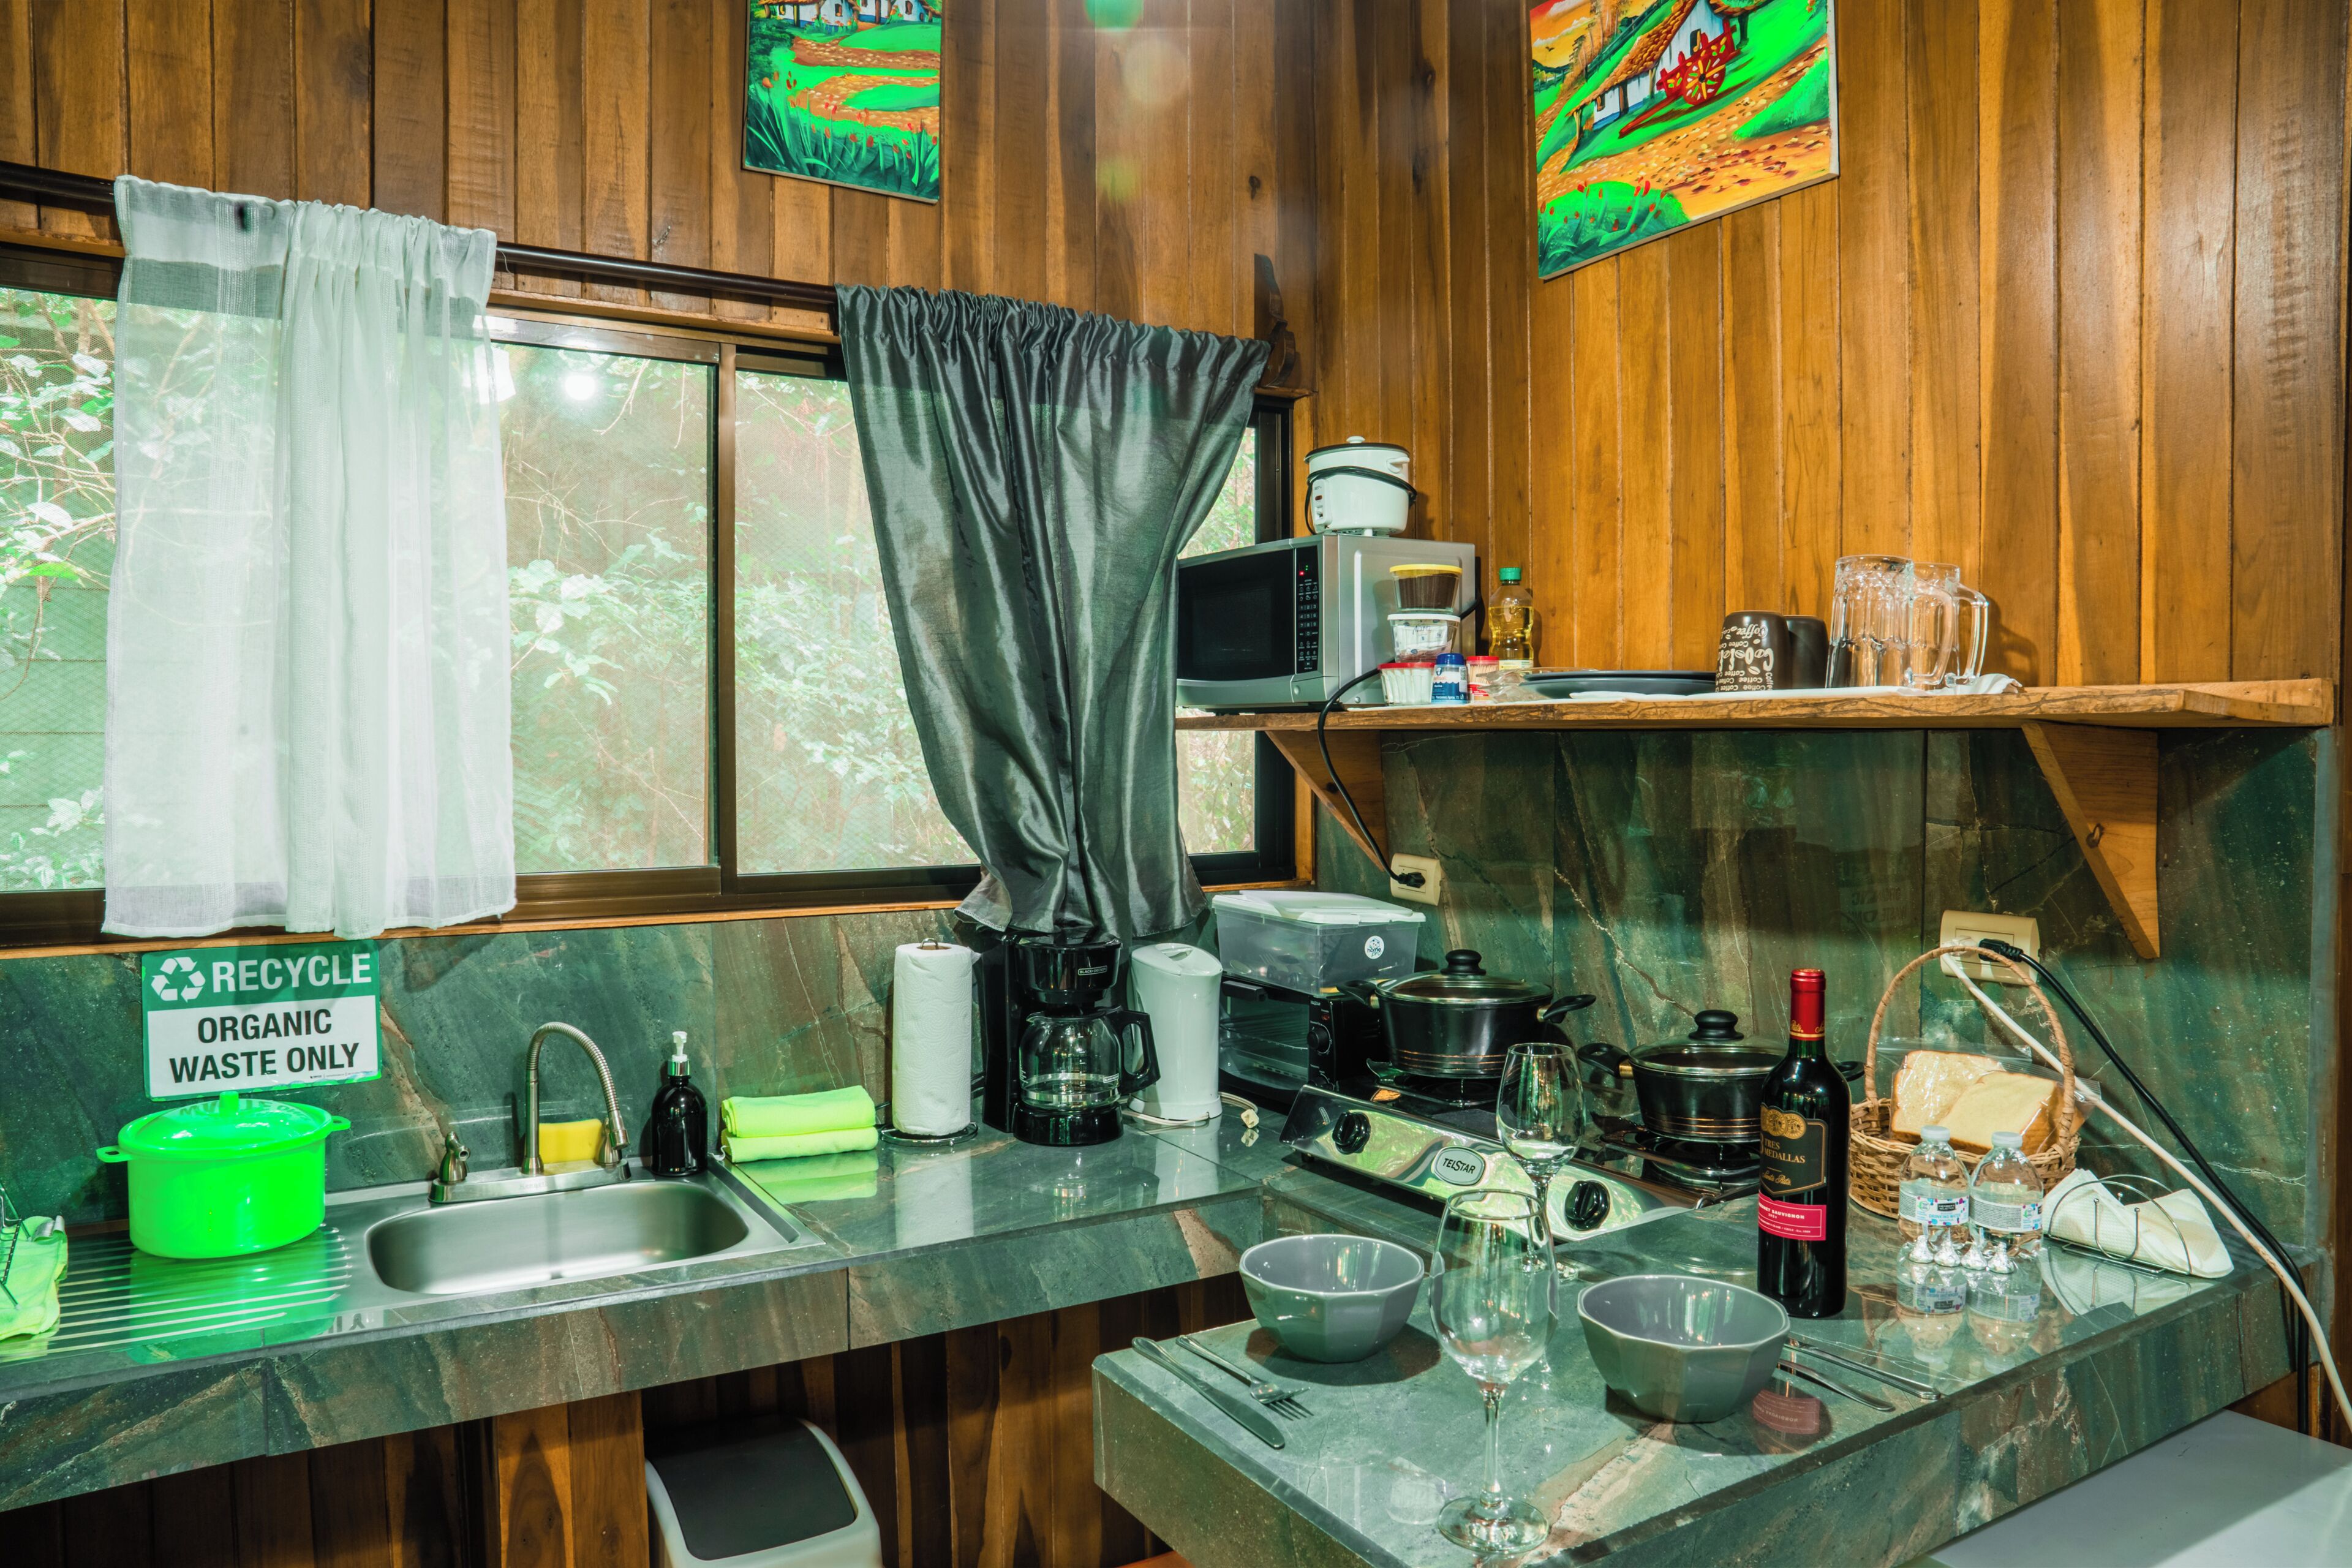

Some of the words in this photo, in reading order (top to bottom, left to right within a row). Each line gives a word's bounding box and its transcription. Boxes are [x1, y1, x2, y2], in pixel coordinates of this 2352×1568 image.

[1736, 624, 1768, 639] Coffee
[212, 953, 372, 993] RECYCLE
[198, 1008, 332, 1043] ORGANIC
[169, 1049, 276, 1084] WASTE
[287, 1042, 360, 1072] ONLY
[1765, 1139, 1780, 1150] TRES
[1764, 1147, 1806, 1163] MEDALLAS
[1442, 1158, 1476, 1174] TELSTAR
[1771, 1209, 1804, 1219] SAUVIGNON
